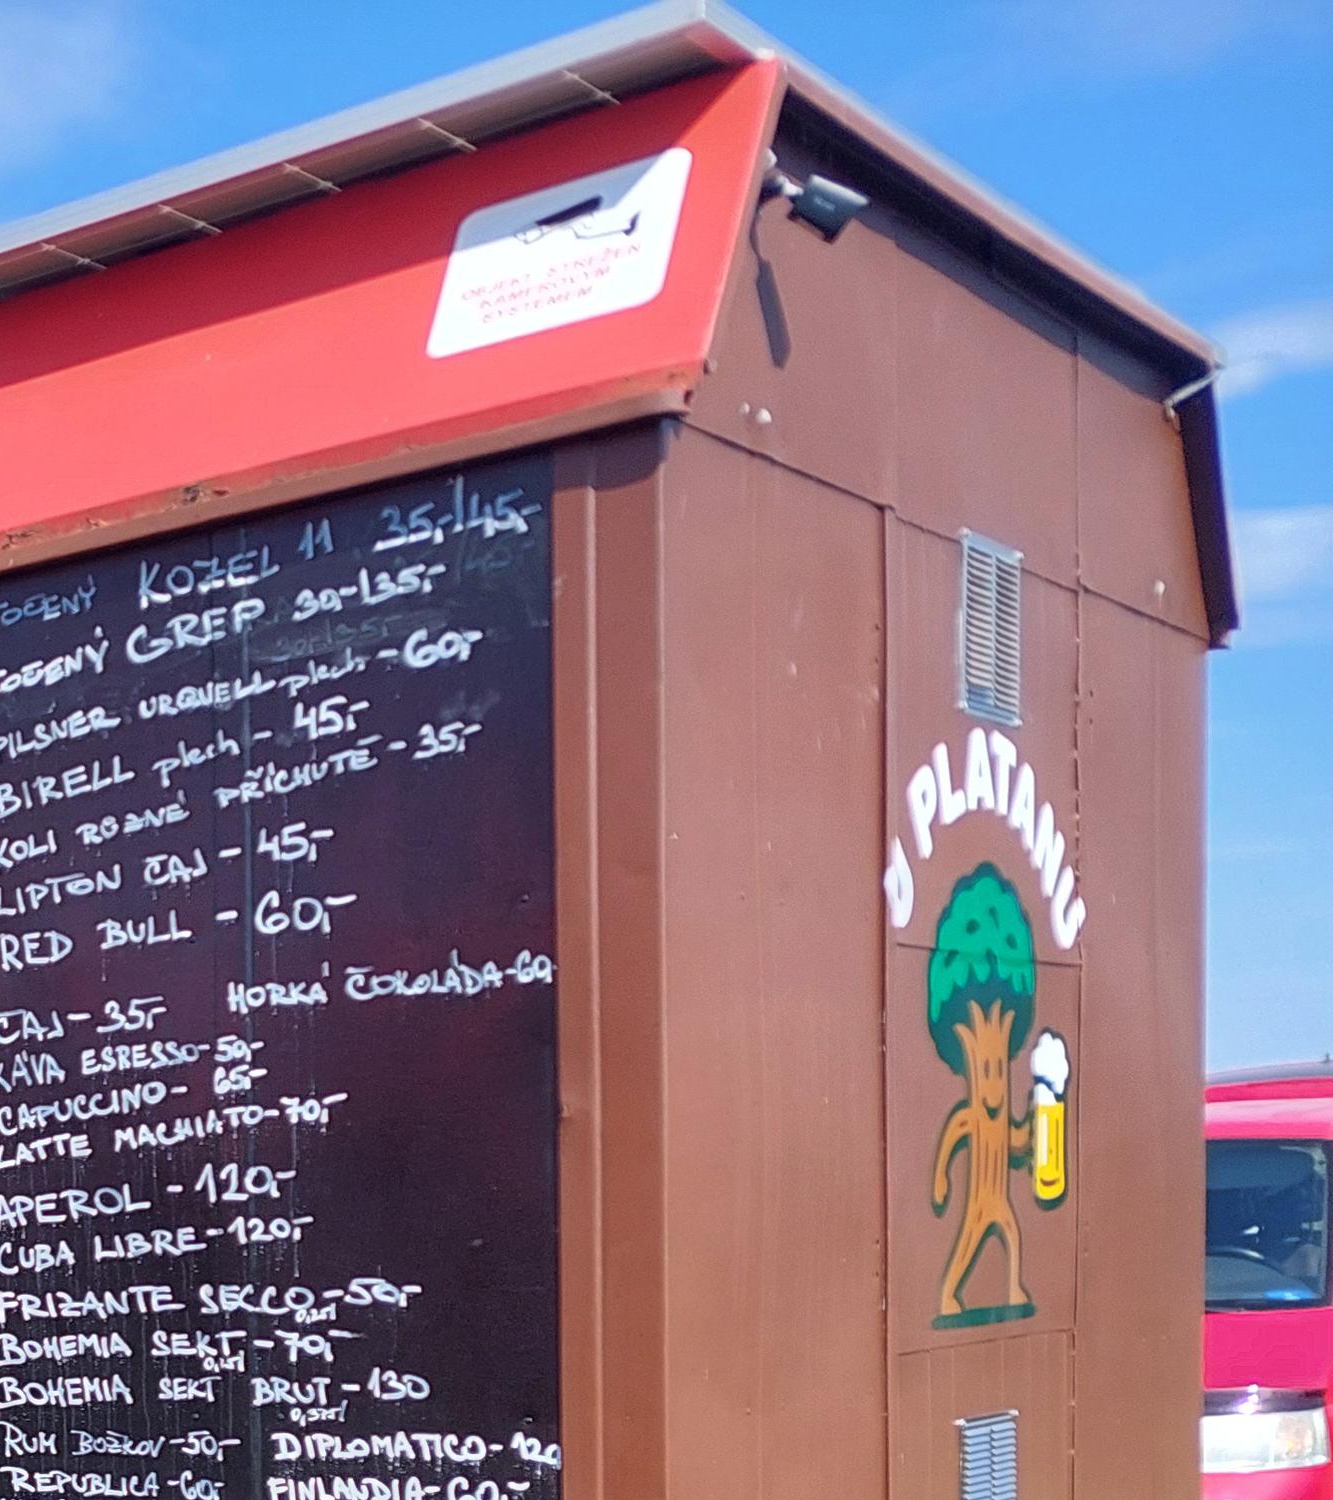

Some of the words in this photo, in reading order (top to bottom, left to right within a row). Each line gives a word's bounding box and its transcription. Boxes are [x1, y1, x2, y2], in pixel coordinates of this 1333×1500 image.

[138, 545, 280, 610] KOZEL
[298, 518, 333, 560] 11
[126, 597, 267, 664] GREP
[883, 834, 915, 928] U
[906, 727, 1086, 950] PLATANU
[97, 909, 193, 951] BULL
[95, 1225, 207, 1261] LIBRE
[199, 1284, 315, 1314] SECCO
[151, 1330, 247, 1358] SEKT
[158, 1375, 223, 1402] SEKT
[251, 1376, 331, 1406] BRUT
[270, 1431, 487, 1462] DIPLOMATICO
[0, 1466, 160, 1497] REPUBLICA
